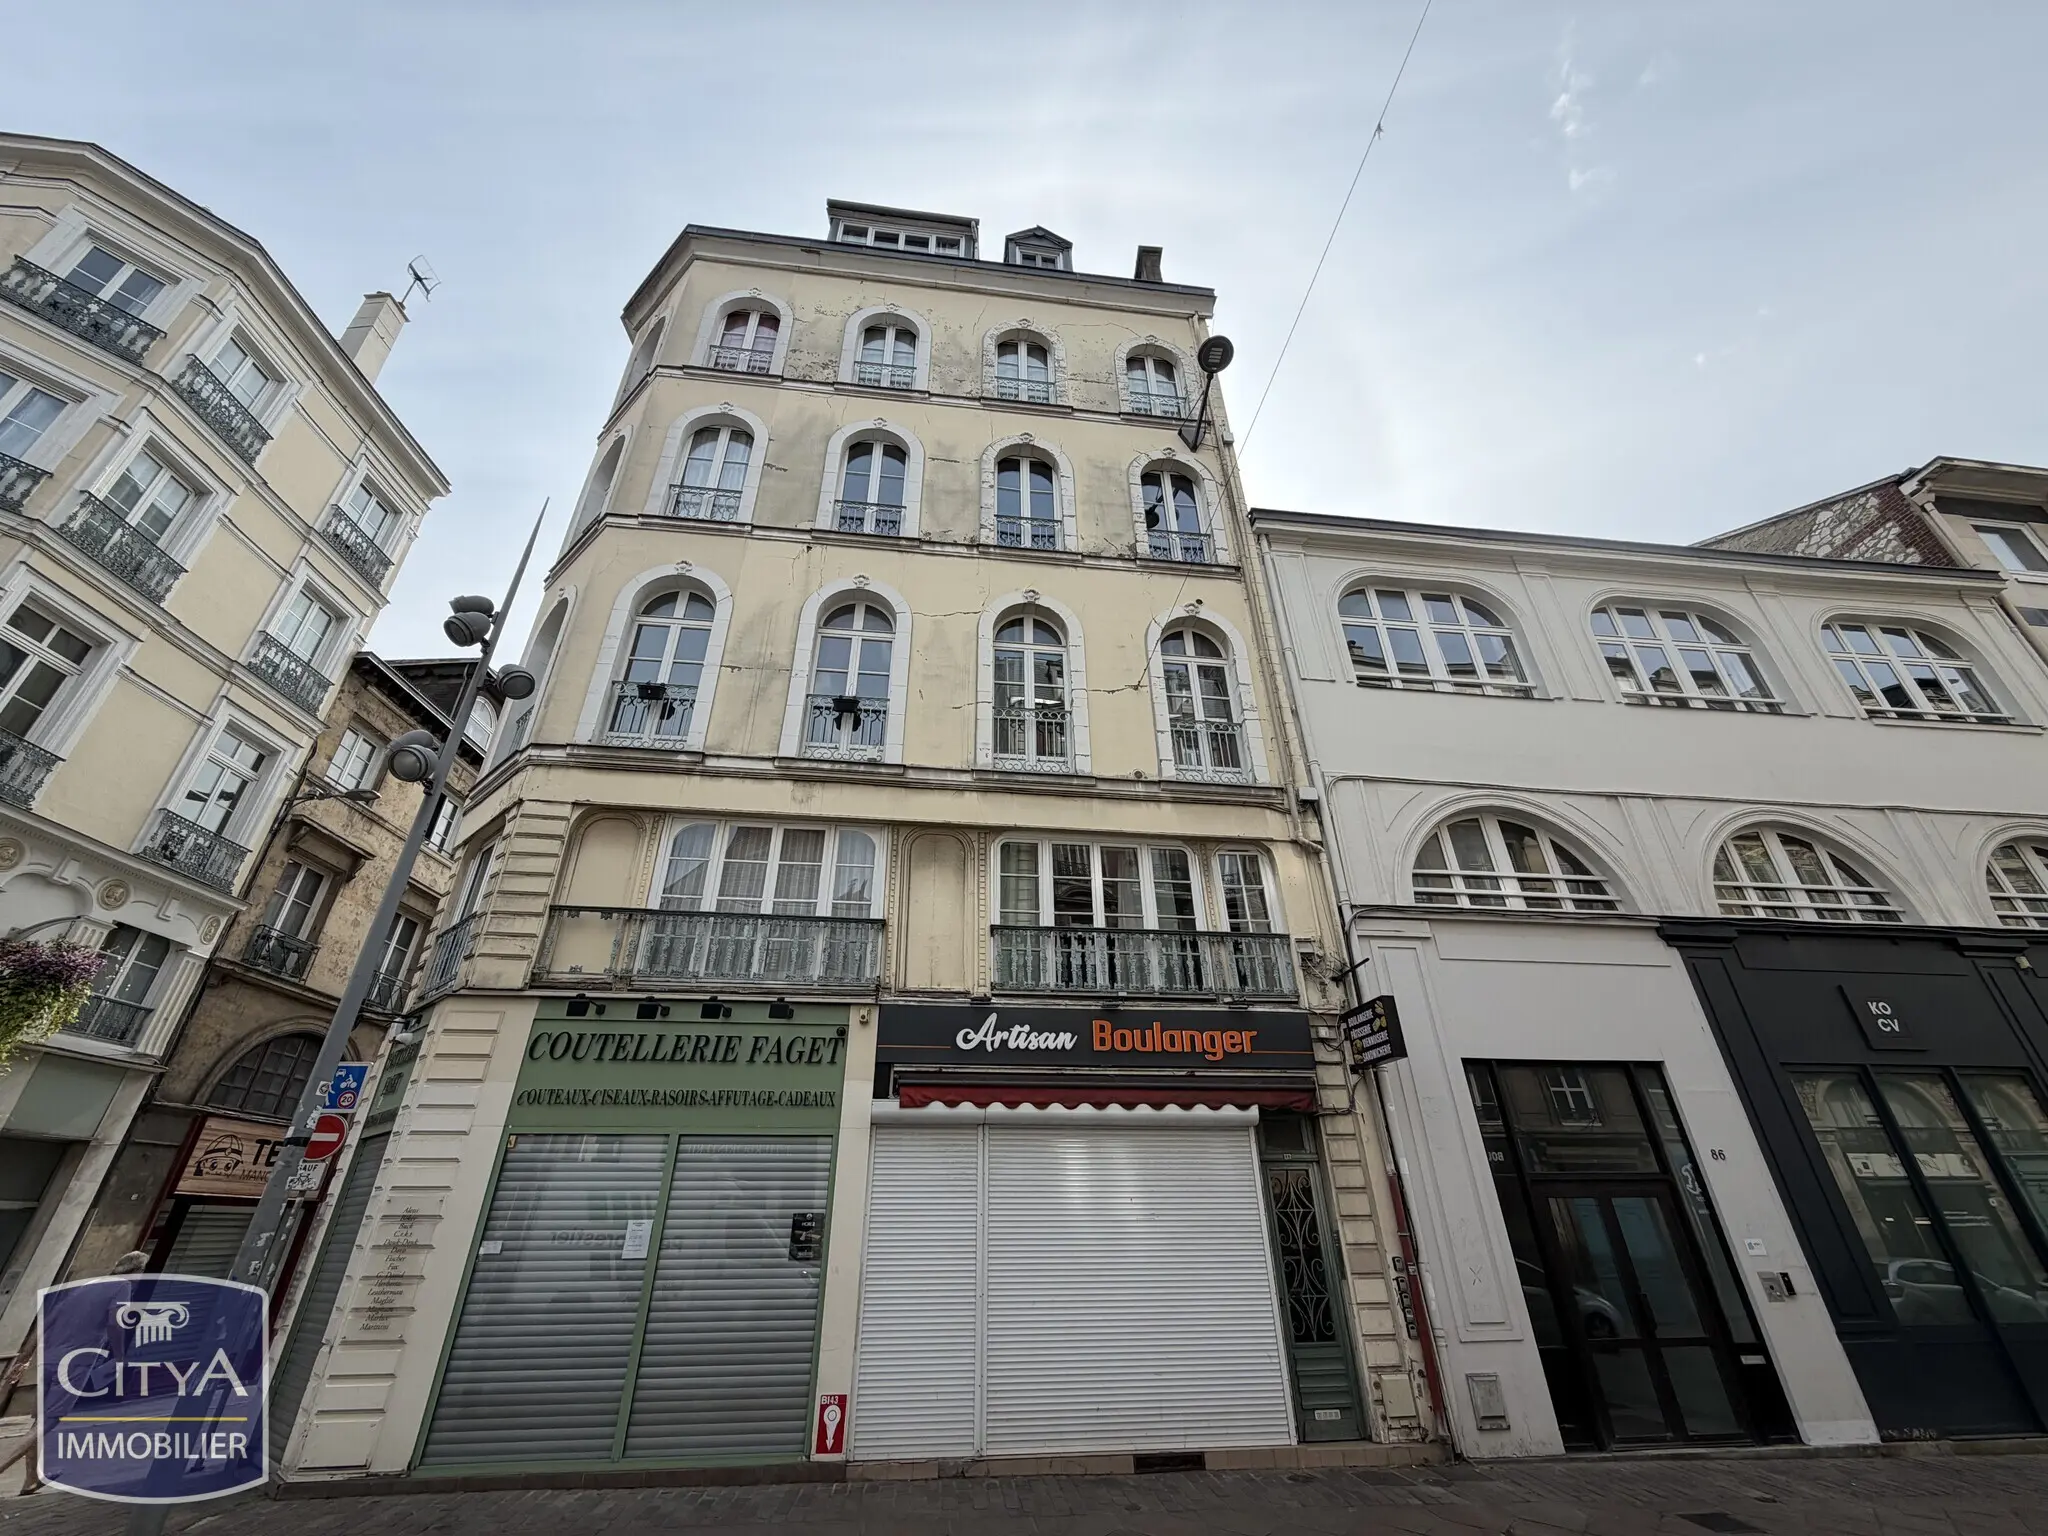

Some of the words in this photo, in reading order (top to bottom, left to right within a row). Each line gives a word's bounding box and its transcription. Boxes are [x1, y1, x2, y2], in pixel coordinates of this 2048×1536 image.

[955, 1012, 1078, 1052] Artisan
[1092, 1019, 1258, 1061] Boulanger
[528, 1031, 741, 1064] COUTELLERIE
[745, 1035, 846, 1066] FAGET
[341, 1095, 353, 1103] 20
[1710, 1149, 1726, 1161] 86
